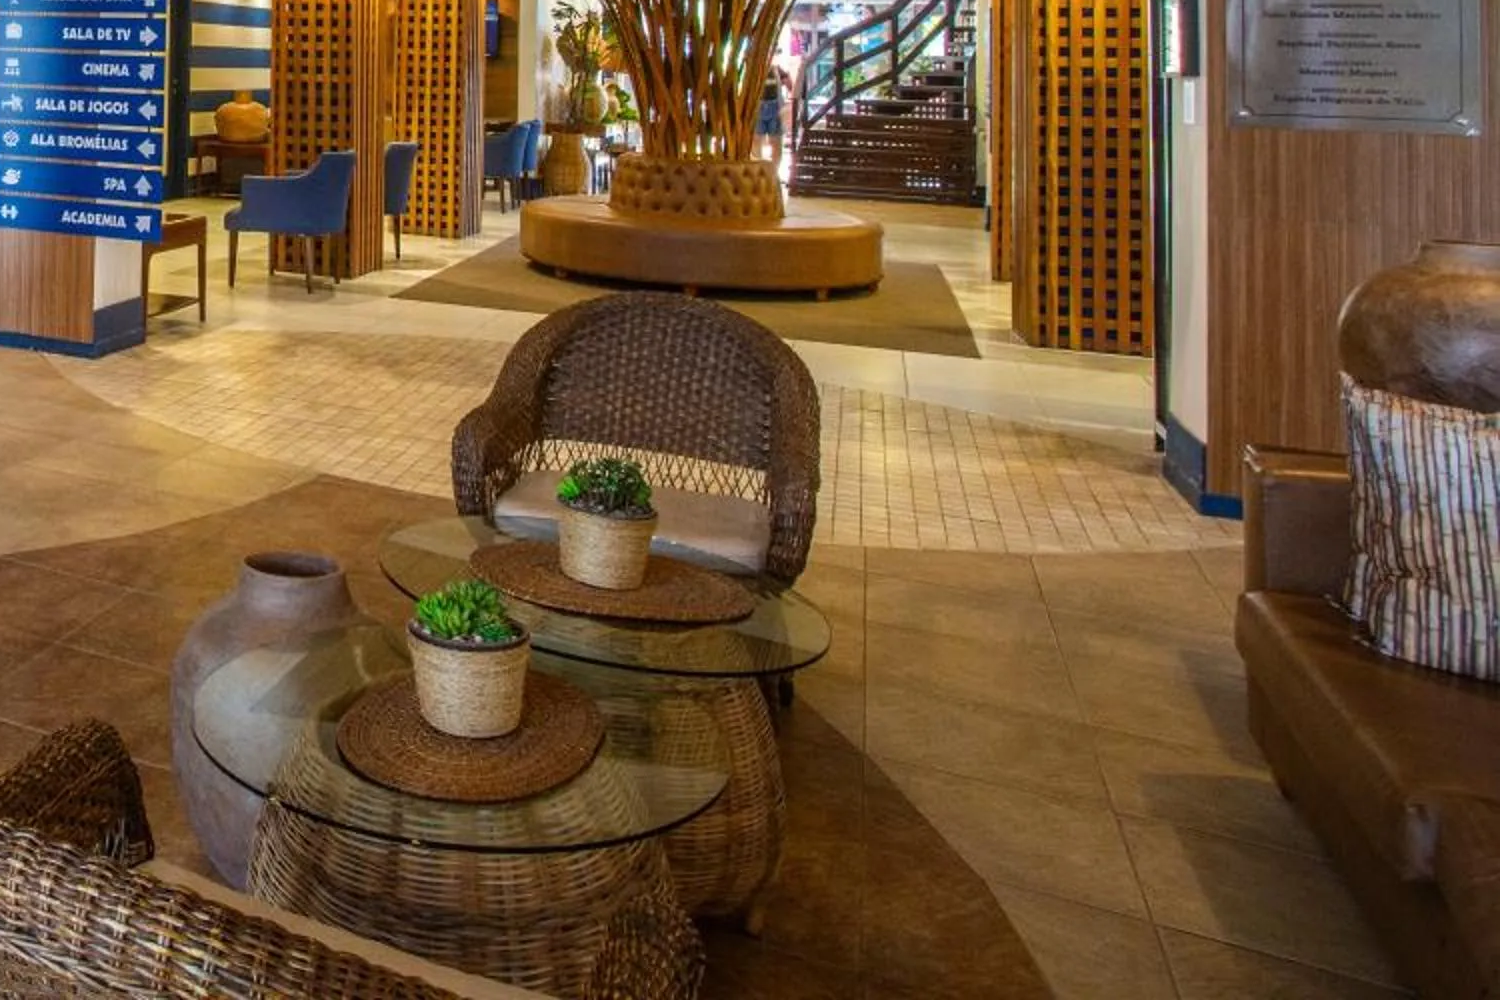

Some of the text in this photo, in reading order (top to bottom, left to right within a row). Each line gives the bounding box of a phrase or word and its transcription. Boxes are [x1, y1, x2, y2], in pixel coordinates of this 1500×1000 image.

[63, 28, 131, 41] SALA DE TV
[82, 63, 129, 77] CINEMA
[36, 98, 129, 115] SALA DE JOGOS
[31, 131, 128, 151] ALA BROMÉLIAS
[104, 177, 126, 191] SPA
[62, 210, 126, 229] ACADEMIA
